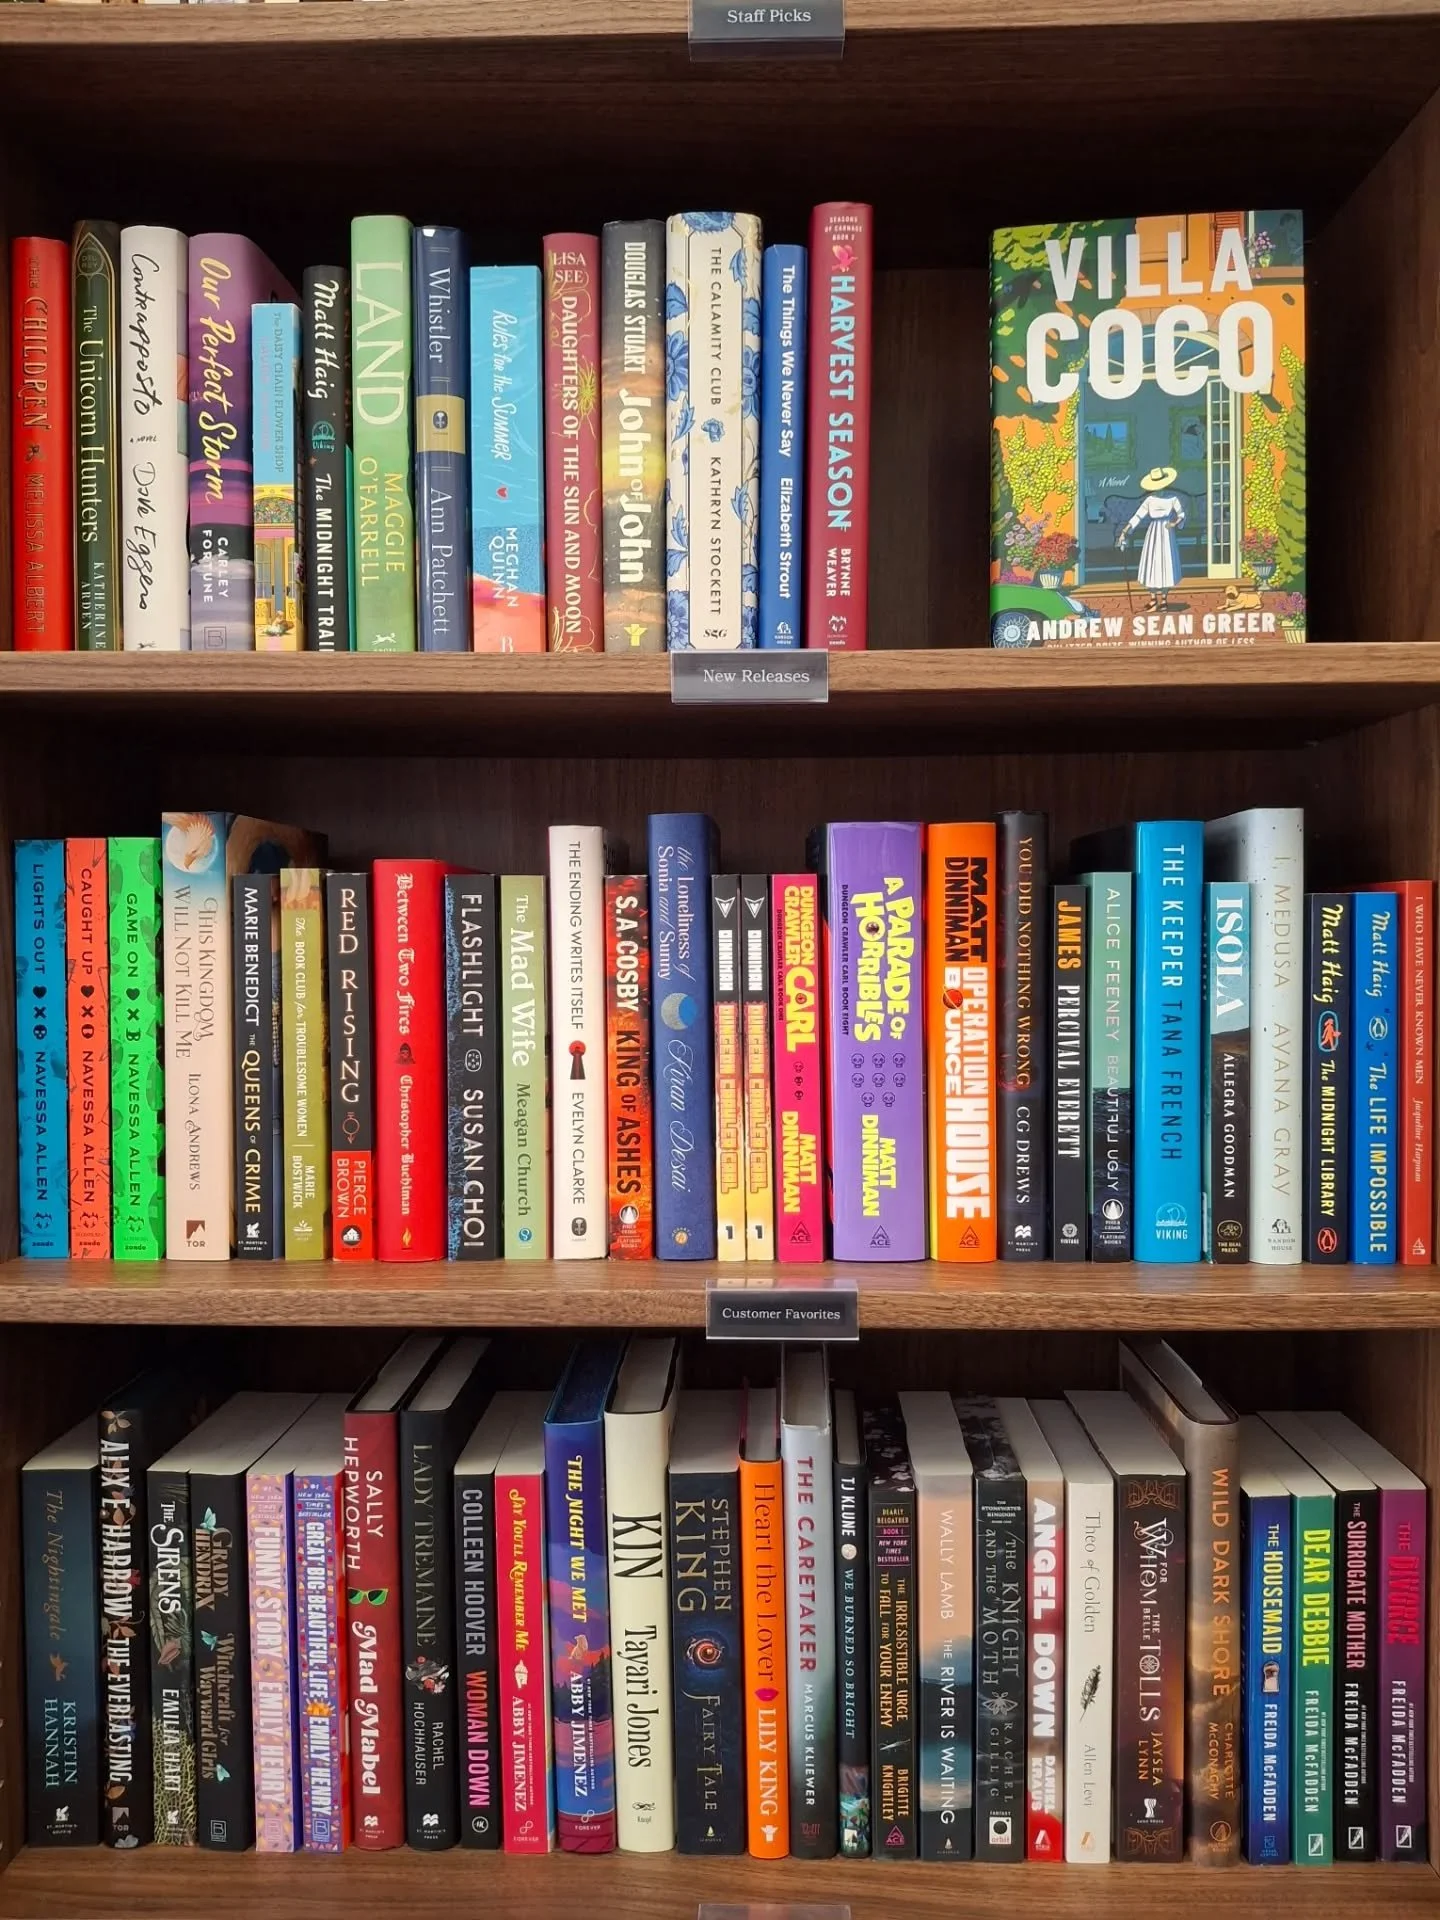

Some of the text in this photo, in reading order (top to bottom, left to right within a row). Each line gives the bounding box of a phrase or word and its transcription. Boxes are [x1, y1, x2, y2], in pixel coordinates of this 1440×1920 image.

[728, 9, 812, 23] Staff Picks
[427, 268, 451, 364] Whistler
[553, 252, 586, 266] LISA
[555, 269, 584, 283] SEE
[623, 241, 647, 374] DOUGLAS STUART
[1045, 227, 1254, 302] VILLA
[129, 253, 162, 416] Contrapposto
[199, 256, 237, 505] Our Perfect Storm
[307, 279, 341, 400] Matt Haig
[355, 262, 405, 426] LAND
[710, 247, 721, 406] THE CALAMITY CLUB
[778, 265, 795, 458] The Things We Never Say
[1026, 301, 1273, 404] COCO
[79, 305, 105, 542] The Unicorn Hunters
[827, 275, 856, 532] HARVEST SEASON
[359, 456, 379, 587] O'FARRELL
[384, 472, 405, 573] MAGGIE
[560, 296, 581, 634] DAUGHTERS OF THE SUN AND MOON
[618, 388, 653, 584] John OF John
[127, 462, 157, 610] Dave Eggers
[202, 529, 213, 603] FORTUNE
[217, 537, 228, 599] CARLEY
[314, 474, 335, 652] The MIDNIGHT TRAI
[430, 487, 454, 637] Ann Patchett
[710, 457, 721, 615] KATHRYN STOCKETT
[779, 478, 793, 599] Elizabeth Strout
[827, 548, 837, 598] WEAVER
[840, 548, 851, 598] BRYNNE
[82, 583, 91, 630] ARDEN
[93, 562, 106, 650] KATHERINE
[1026, 612, 1276, 641] ANDREW SEAN GREER
[703, 669, 810, 683] New Releases
[32, 863, 46, 976] LIGHTS OUT
[461, 893, 484, 1038] FLASHLIGHT
[569, 841, 584, 1030] THE ENDING WRITES ITSELF
[1057, 900, 1082, 969] JAMES
[1161, 844, 1185, 988] THE KEEPER
[1215, 897, 1245, 1018] ISOLA
[1416, 903, 1424, 931] WHO
[1416, 933, 1424, 966] HAVE
[338, 887, 360, 1104] RED RISING
[510, 894, 536, 1067] The Mad Wife
[1415, 1005, 1424, 1056] KNOWN
[1416, 968, 1424, 1003] NEVER
[35, 1051, 48, 1201] NAVESSA ALLEN
[1057, 984, 1081, 1159] PERCIVAL EVERETT
[1161, 1000, 1183, 1160] TANA FRENCH
[1223, 1053, 1235, 1199] ALLEGRA GOODMAN
[1415, 1058, 1424, 1084] MEN
[336, 1157, 349, 1219] BROWN
[353, 1160, 367, 1216] PIERCE
[462, 1089, 485, 1248] SUSAN CHOI
[513, 1083, 532, 1217] Meagan Church
[572, 1092, 585, 1205] EVELYN CLARKE
[186, 1240, 206, 1248] TOR
[870, 1236, 891, 1246] ACE
[1155, 1230, 1188, 1240] VIKING
[722, 1308, 841, 1319] Customer Favorites
[343, 1437, 361, 1571] HEPWORTH
[365, 1469, 384, 1538] SALLY
[612, 1512, 663, 1579] KIN
[462, 1489, 486, 1657] COLLEEN HOOVER
[753, 1482, 777, 1679] Heart the Lover
[939, 1509, 954, 1620] WALLY LAMB
[1211, 1468, 1230, 1697] WILD DARK SHORE
[1262, 1523, 1282, 1656] THE HOUSEMAID
[1302, 1527, 1331, 1667] DEAR DEBBIE
[43, 1697, 60, 1789] HANNAH
[63, 1699, 78, 1784] KRISTIN
[352, 1621, 381, 1796] Mad Mabel
[465, 1670, 490, 1807] WOMAN DOWN
[624, 1624, 659, 1769] Tayari Jones
[941, 1639, 955, 1826] THE RIVER IS WAITING
[1304, 1690, 1319, 1813] FREIDA McFADDEN
[756, 1708, 779, 1816] LILY KING
